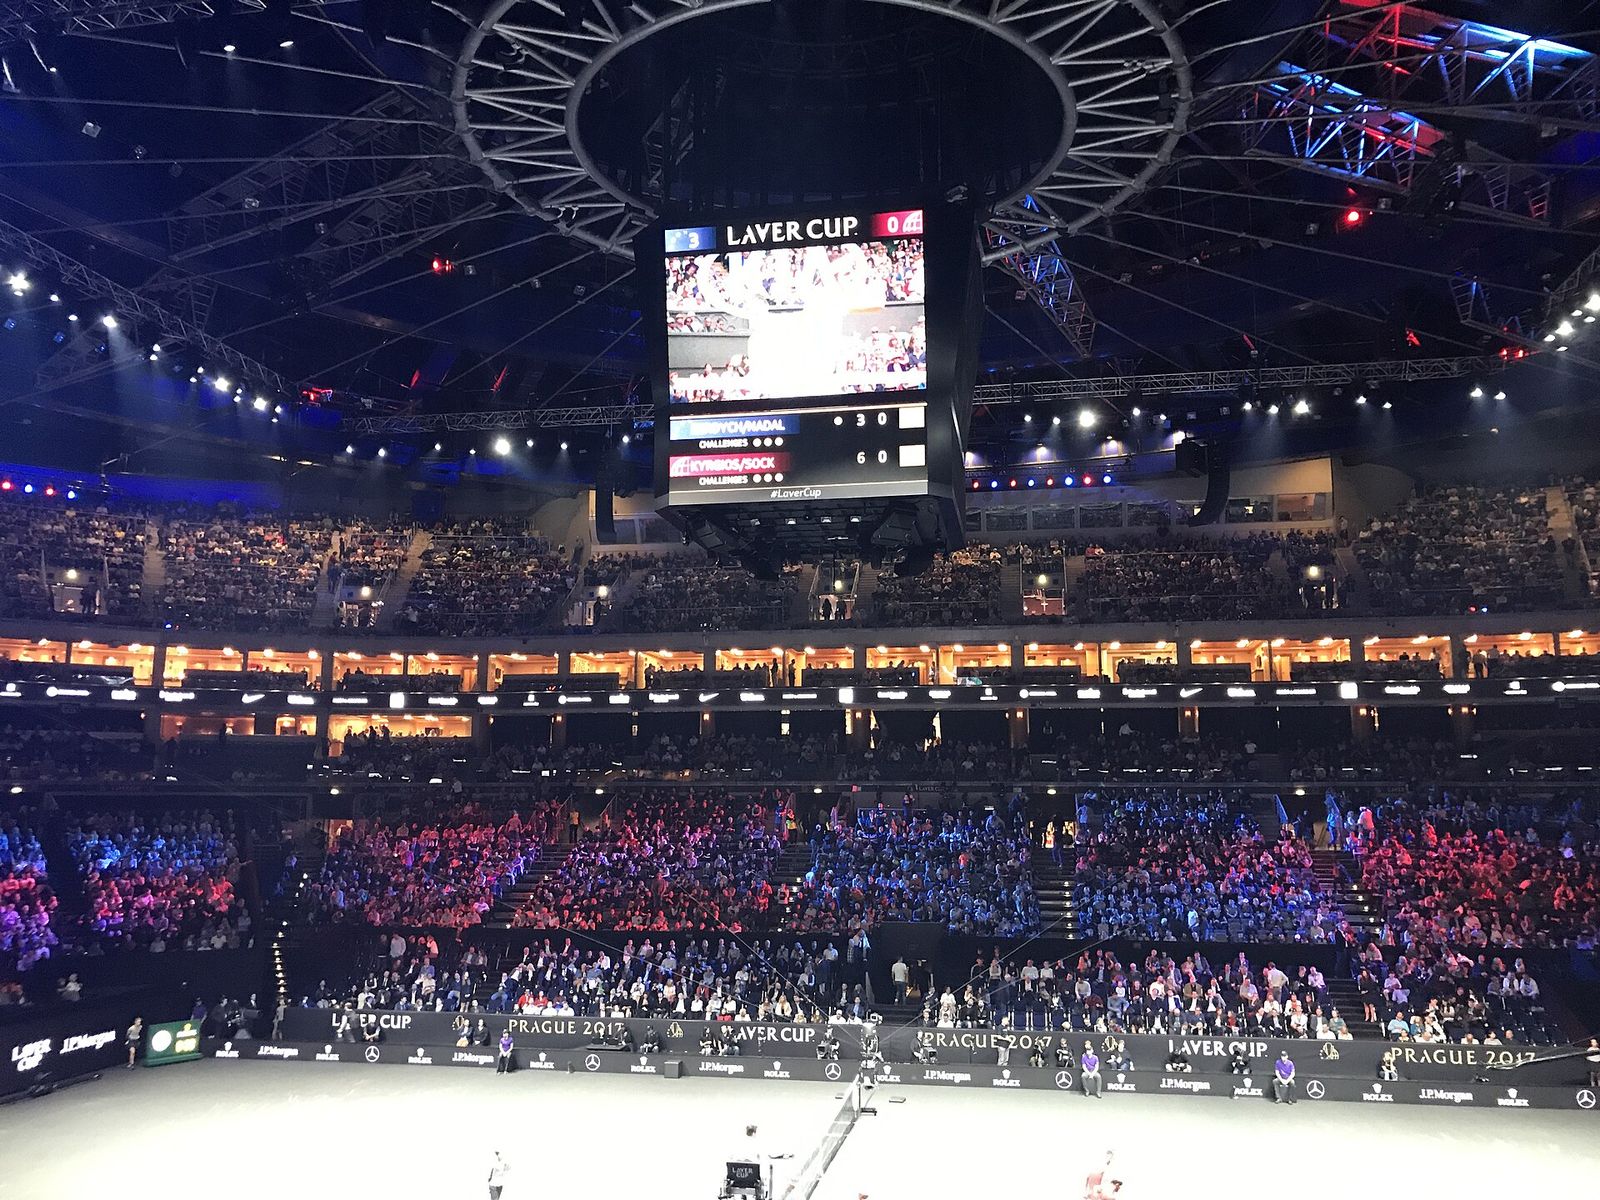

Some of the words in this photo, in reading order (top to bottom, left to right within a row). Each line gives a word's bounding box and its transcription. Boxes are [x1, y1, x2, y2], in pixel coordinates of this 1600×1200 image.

[887, 217, 896, 234] 0
[688, 232, 700, 249] 3
[726, 221, 804, 247] LAVER
[856, 413, 866, 427] 3
[877, 412, 888, 426] 0
[698, 438, 749, 449] CHALLENGES
[856, 451, 866, 464] 6
[877, 450, 888, 463] 0
[698, 475, 749, 486] CHALLENGES
[770, 488, 822, 499] #LaverCup
[508, 1019, 577, 1035] PRAGUE
[924, 1032, 1000, 1049] PRAGUE
[1391, 1047, 1478, 1066] PRAGUE
[1486, 1051, 1536, 1067] 2017
[529, 1061, 555, 1069] ROLEX
[630, 1065, 656, 1073] ROLEX
[698, 1062, 744, 1075] J.P.Morgan
[764, 1070, 790, 1078] ROLEX
[923, 1069, 971, 1083] J.P.Morgan
[1106, 1082, 1136, 1091] ROLEX
[1159, 1078, 1211, 1092] J.P.Morgan
[1362, 1093, 1394, 1102] ROLEX
[1419, 1088, 1474, 1103] J.P.Morgan
